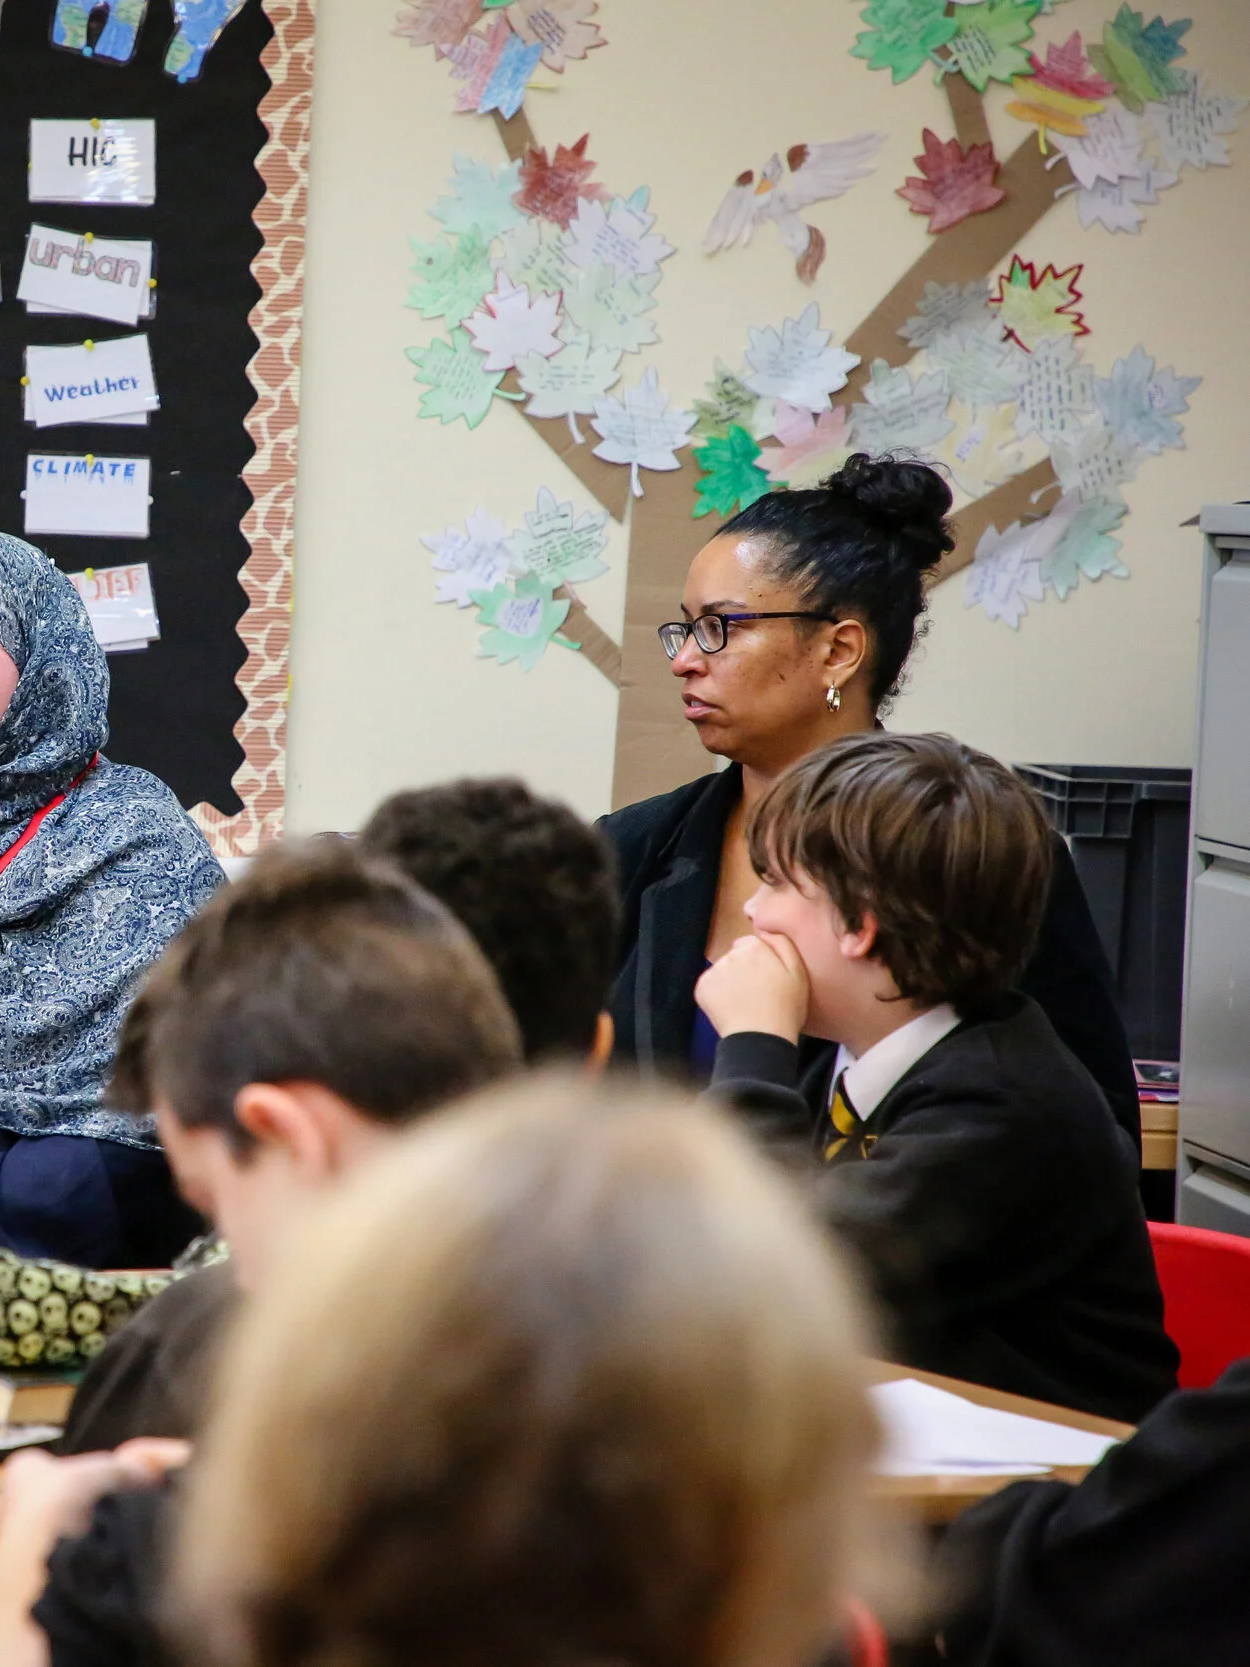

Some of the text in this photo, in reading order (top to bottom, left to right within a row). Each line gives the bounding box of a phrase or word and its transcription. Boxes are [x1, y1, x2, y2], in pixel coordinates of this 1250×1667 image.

[67, 136, 117, 167] HIC
[28, 236, 142, 288] urban
[32, 458, 137, 479] CLIMATE
